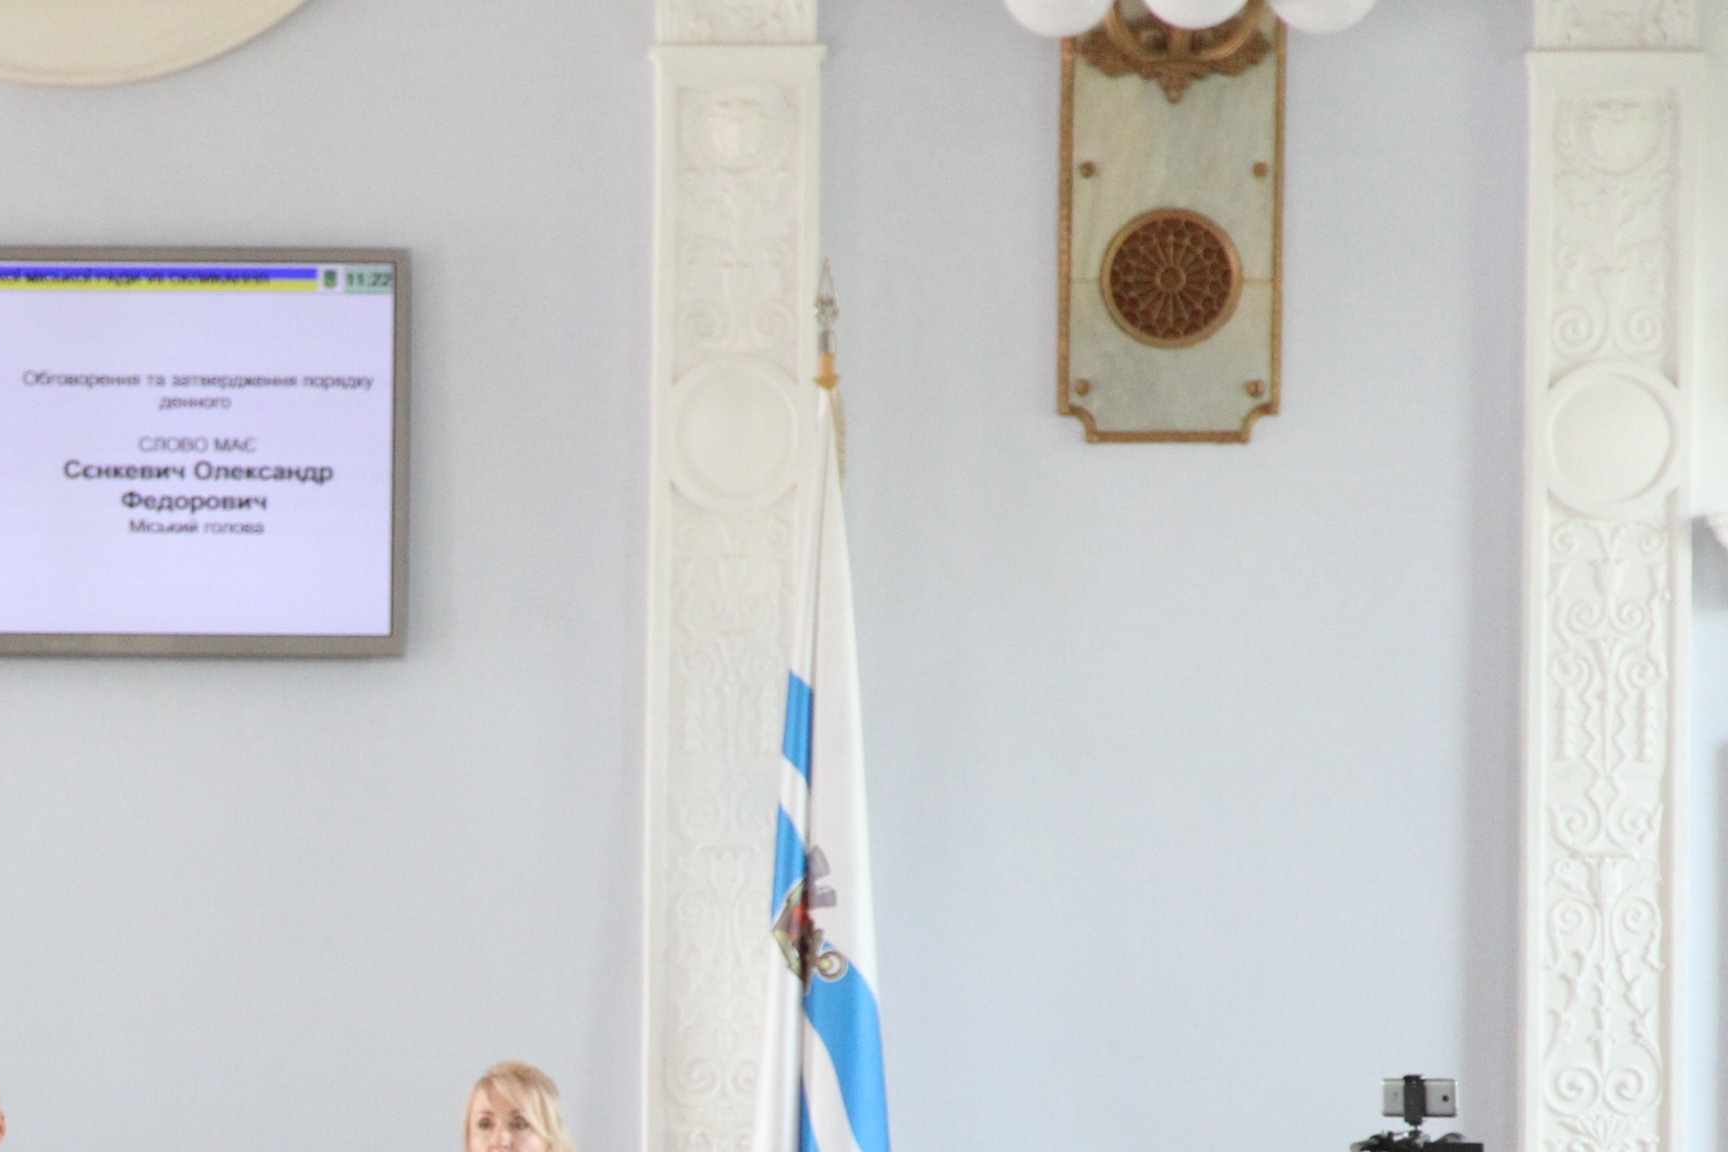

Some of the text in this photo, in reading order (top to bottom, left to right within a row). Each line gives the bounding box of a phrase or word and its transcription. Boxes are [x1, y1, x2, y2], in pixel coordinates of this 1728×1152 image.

[346, 270, 393, 288] 11:22
[146, 373, 166, 387] та
[138, 436, 209, 453] СЛОВО
[192, 460, 334, 486] Олександр
[121, 491, 268, 515] Федорович
[128, 517, 265, 535] Міський голова
